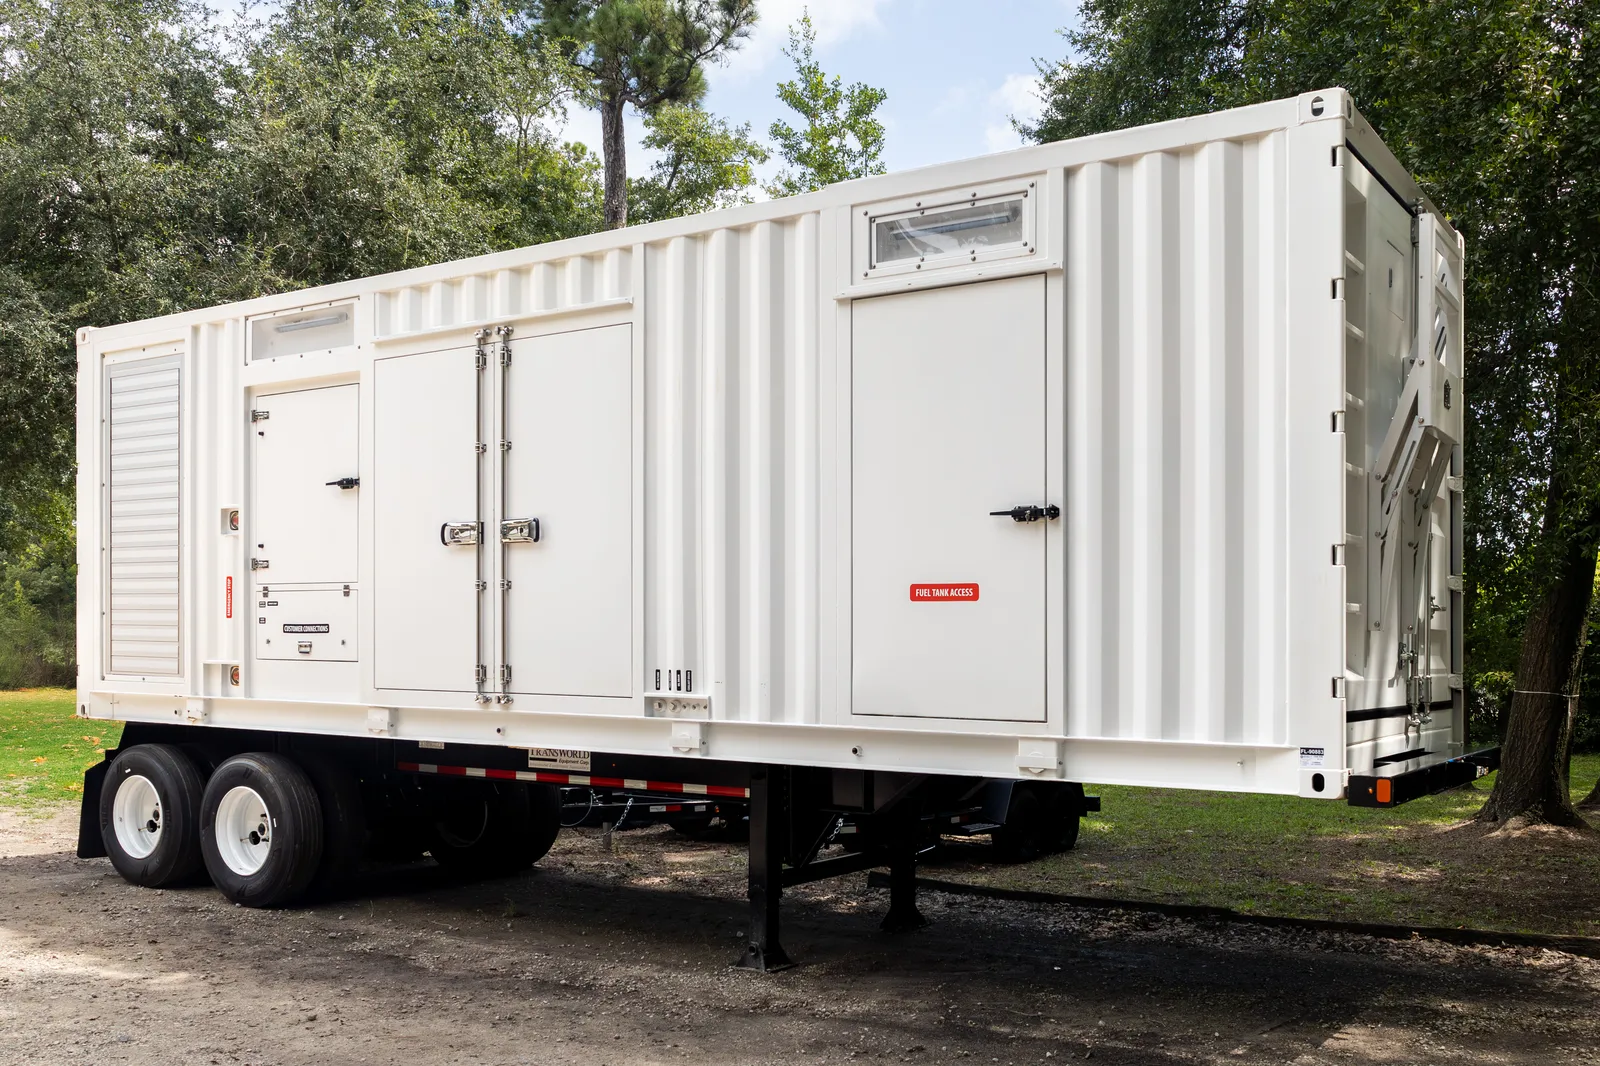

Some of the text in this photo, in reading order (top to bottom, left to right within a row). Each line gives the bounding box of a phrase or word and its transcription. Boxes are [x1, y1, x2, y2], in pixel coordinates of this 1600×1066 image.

[916, 588, 973, 596] FUEL TANK ACCESS
[530, 748, 590, 759] TRANSWORLD
